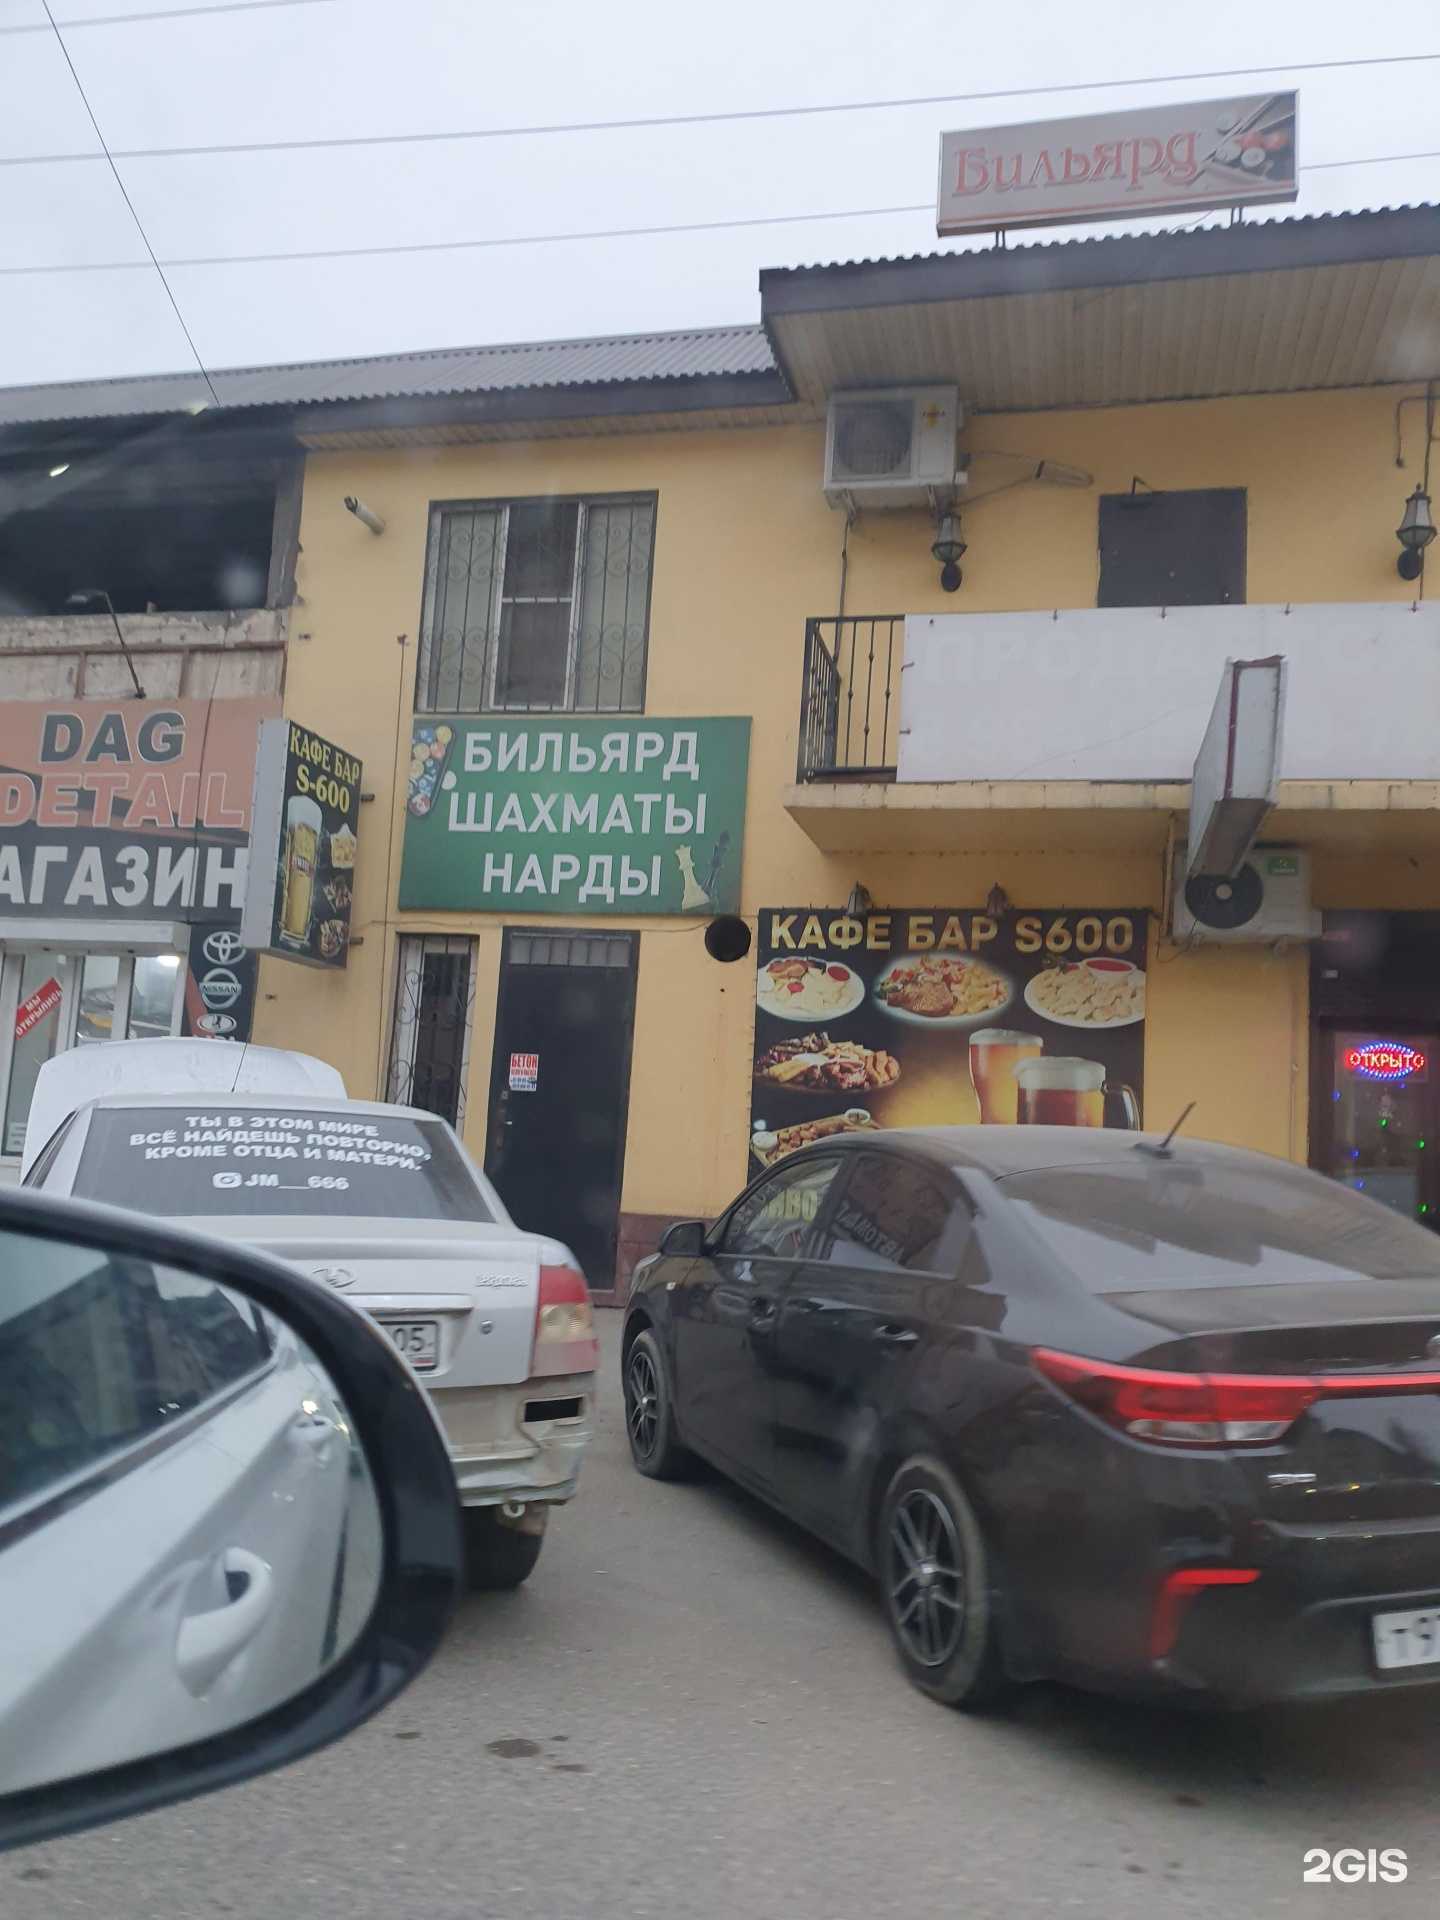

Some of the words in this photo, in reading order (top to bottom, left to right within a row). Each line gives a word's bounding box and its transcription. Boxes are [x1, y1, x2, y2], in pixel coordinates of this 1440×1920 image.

[952, 129, 1202, 197] Бильярд
[38, 710, 187, 765] DAG
[290, 726, 331, 772] КАФЕ
[335, 751, 360, 786] БАР
[463, 731, 700, 781] БИЛЬЯРД
[0, 772, 245, 829] DETAIL
[296, 764, 350, 814] S-600
[448, 792, 707, 835] ШАХМАТЫ
[482, 852, 662, 904] НАРДЫ
[769, 914, 892, 951] КАФЕ
[908, 914, 999, 952] БАР
[1014, 916, 1134, 953] S600
[202, 983, 239, 994] NISSAN
[1350, 1053, 1425, 1069] ОТКРЫТО
[183, 1128, 301, 1144] НАЙДЕШЬ
[184, 1116, 222, 1128] ТЫ
[227, 1116, 244, 1127] В
[249, 1116, 314, 1131] ЭТОМ
[319, 1120, 379, 1137] МИРЕ
[145, 1144, 228, 1160] КРОМЕ
[233, 1145, 299, 1160] ОТЦА
[303, 1147, 322, 1159] И
